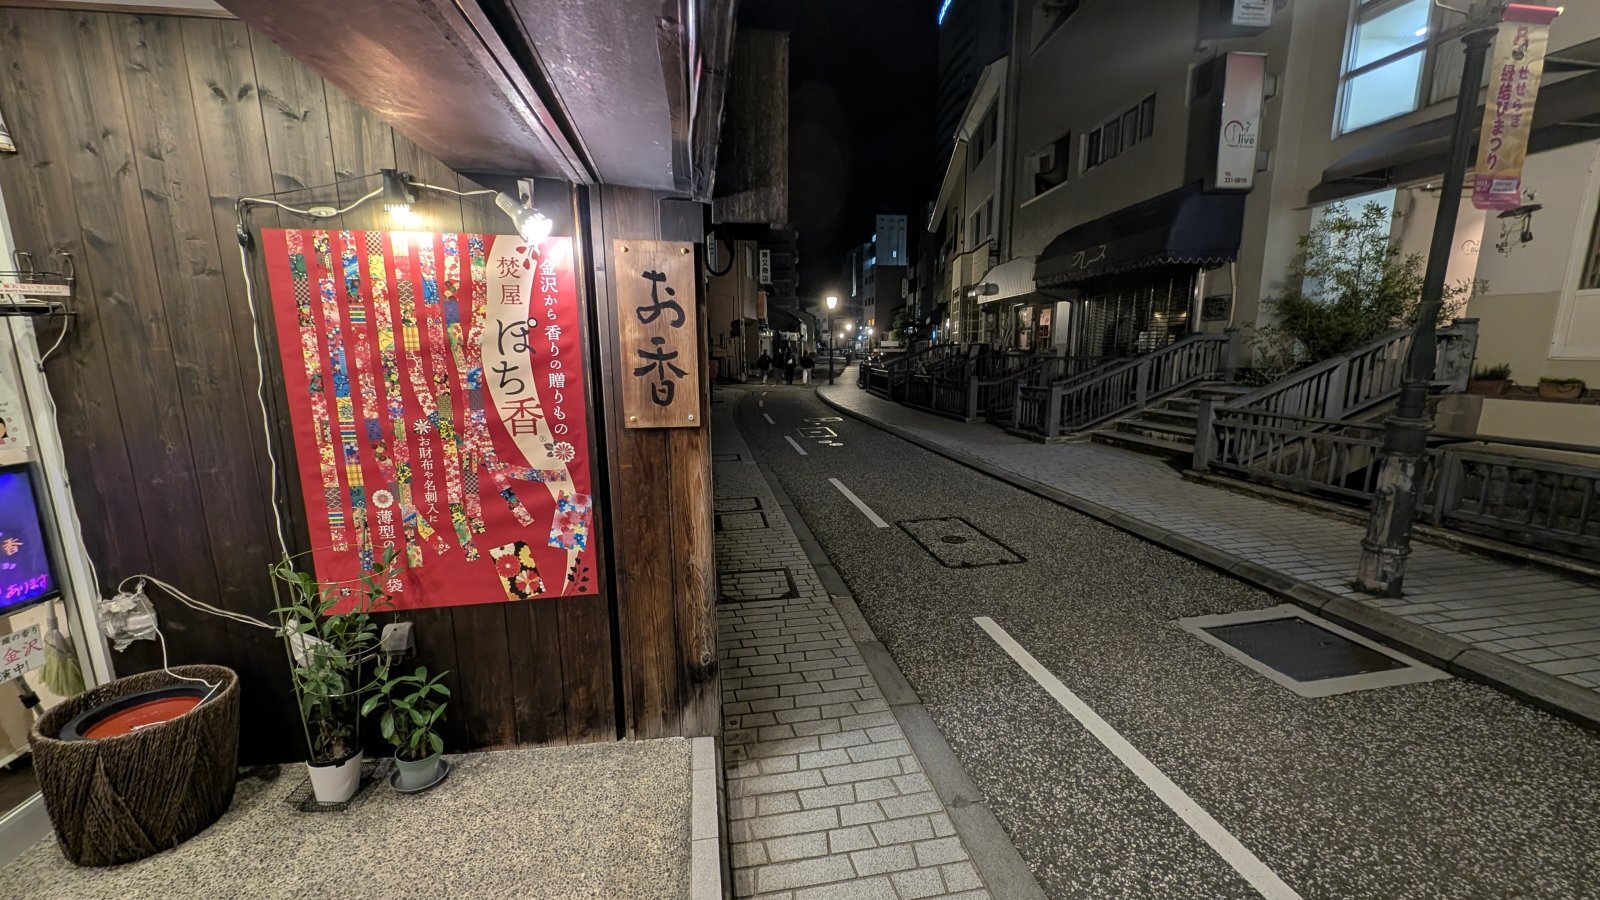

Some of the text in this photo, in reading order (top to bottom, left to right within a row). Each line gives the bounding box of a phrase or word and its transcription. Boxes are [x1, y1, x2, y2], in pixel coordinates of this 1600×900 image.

[1511, 66, 1530, 128] せせらぎ
[491, 256, 545, 437] 焚屋 ぽち香
[539, 259, 568, 434] 金沢から香りの贈りもの
[633, 270, 690, 407] お香
[418, 436, 439, 522] お財布や名刺入に
[0, 573, 48, 599] あります
[376, 510, 403, 592] 薄型の袋
[3, 638, 43, 666] 金沢
